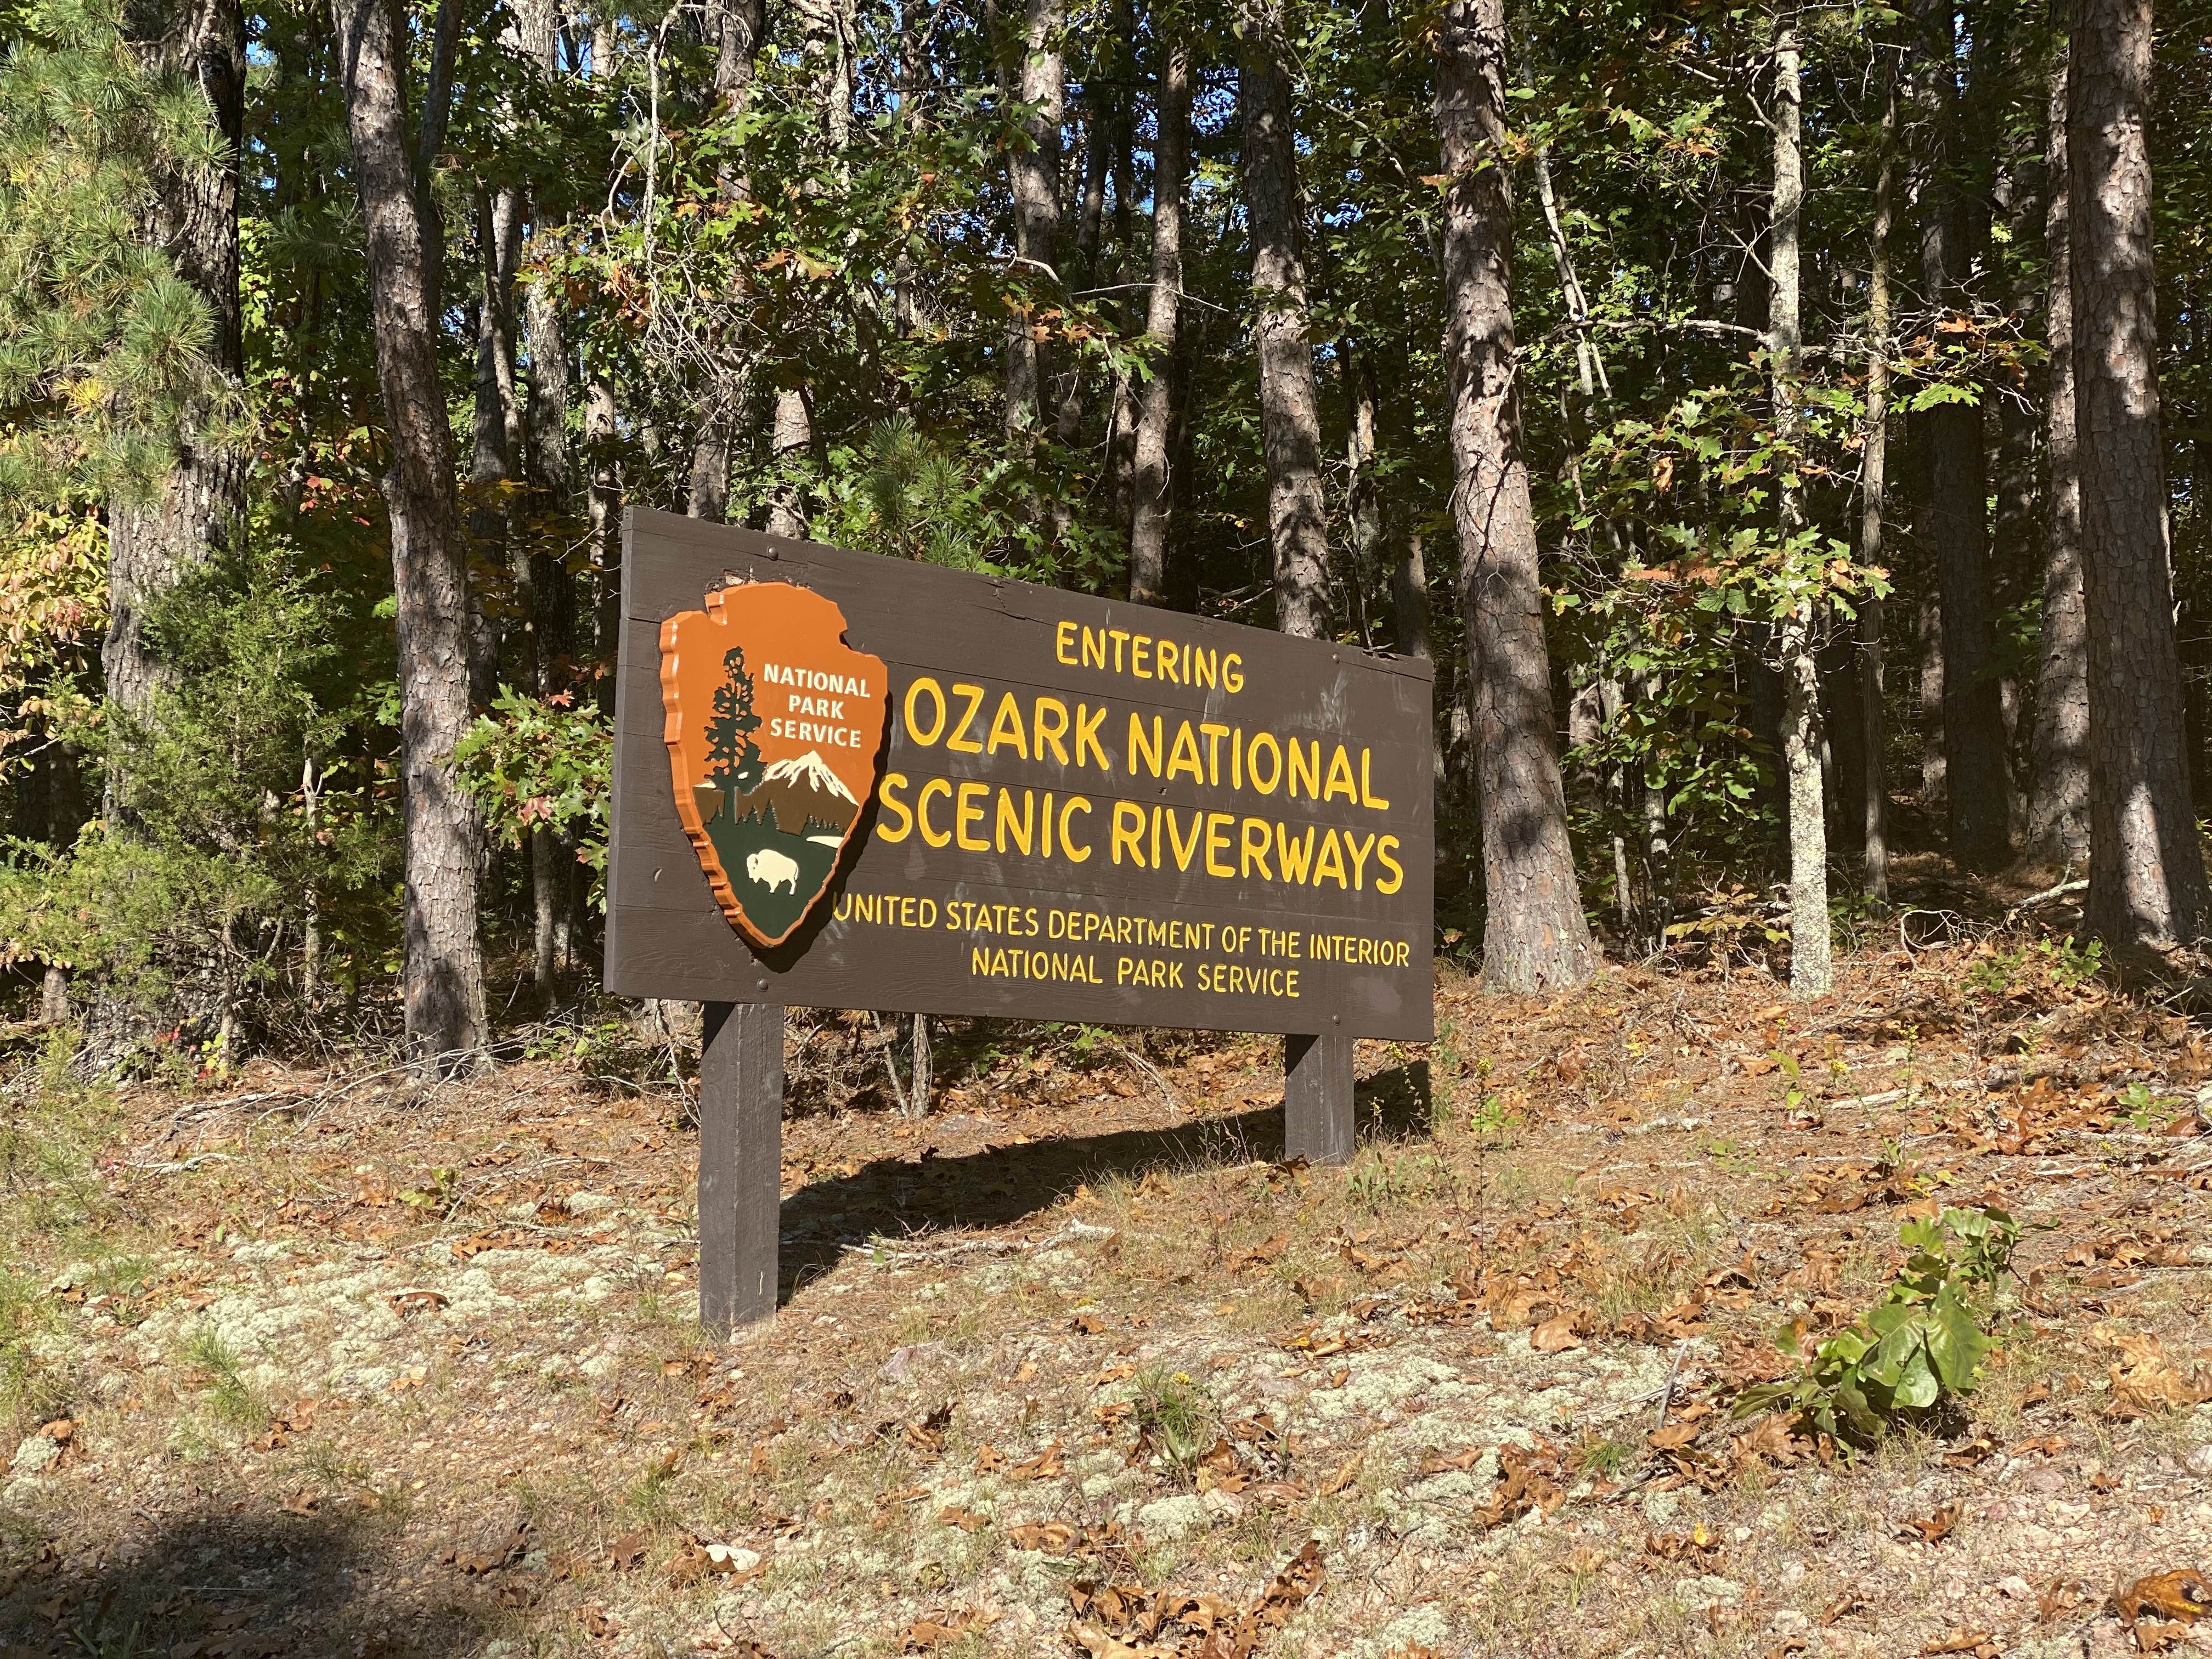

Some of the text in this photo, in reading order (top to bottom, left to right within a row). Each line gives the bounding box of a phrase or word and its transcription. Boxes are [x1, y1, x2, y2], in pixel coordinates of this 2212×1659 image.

[764, 664, 870, 698] NATIONAL
[1056, 620, 1245, 695] ENTERING
[770, 718, 861, 748] SERVICE
[788, 694, 844, 720] PARK
[903, 676, 1390, 811] OZARK NATIONAL
[876, 771, 1406, 895] SCENIC RIVERWAYS
[832, 891, 1411, 967] UNITED STATES DEPARTMENT OF THE INTERIOR
[971, 946, 1300, 998] NATIONAL PARK SERVICE
